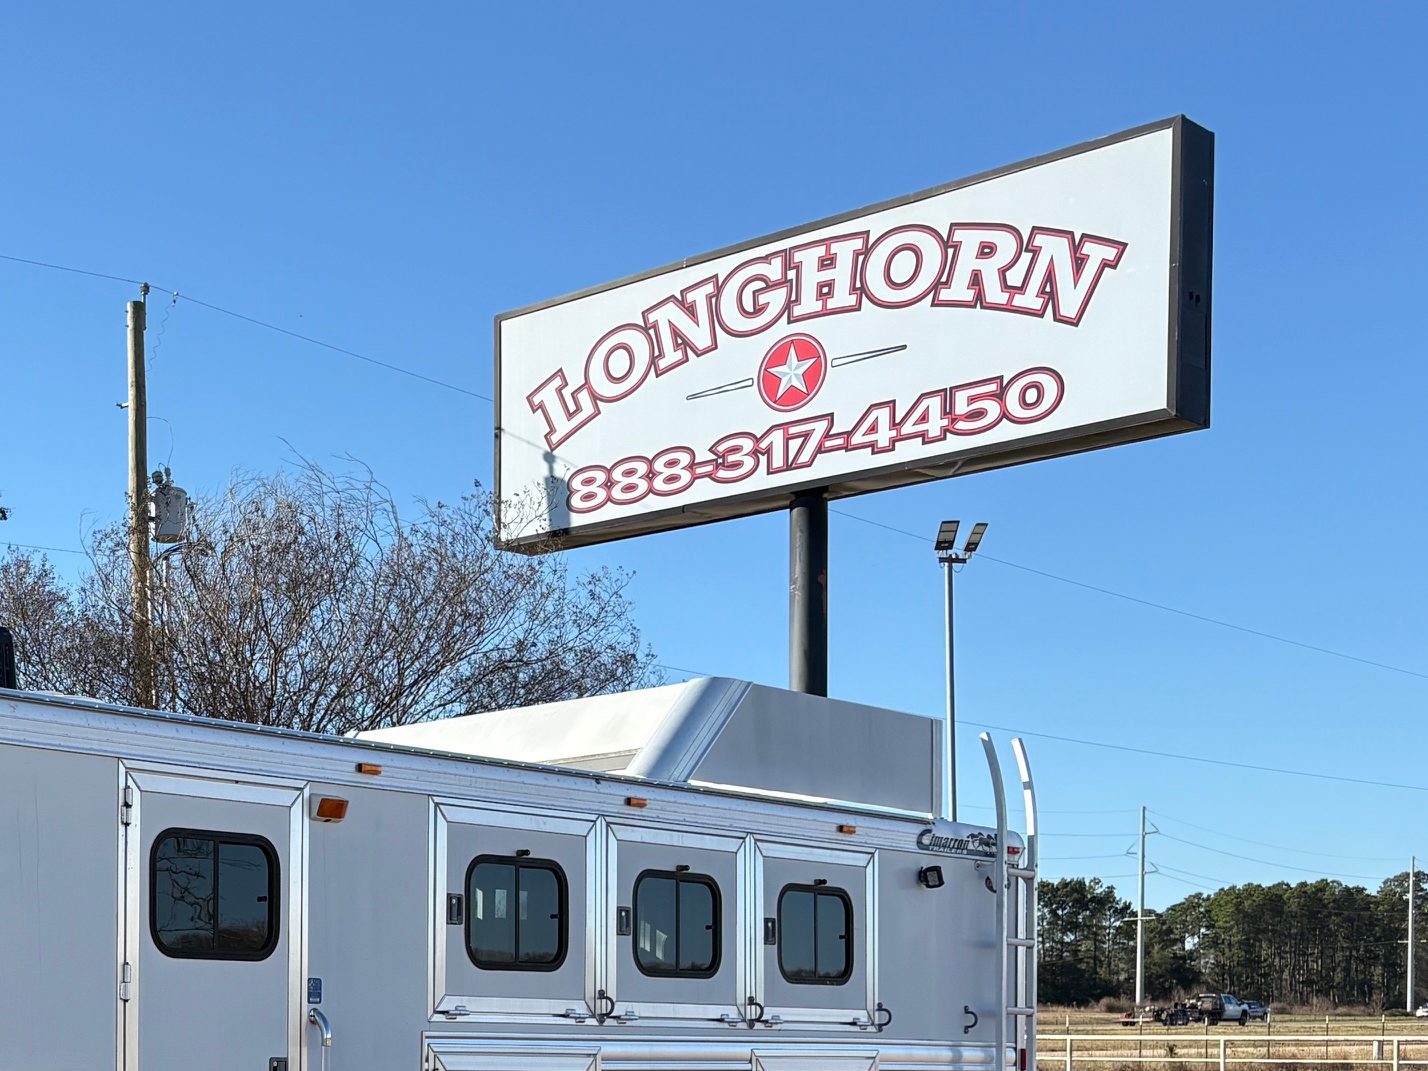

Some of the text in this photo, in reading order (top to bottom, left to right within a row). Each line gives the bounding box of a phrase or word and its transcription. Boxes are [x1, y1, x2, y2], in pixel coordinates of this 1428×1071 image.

[527, 222, 1128, 453] LONGHORN
[566, 366, 1065, 513] 888-317-4450
[917, 828, 970, 851] Cimarron
